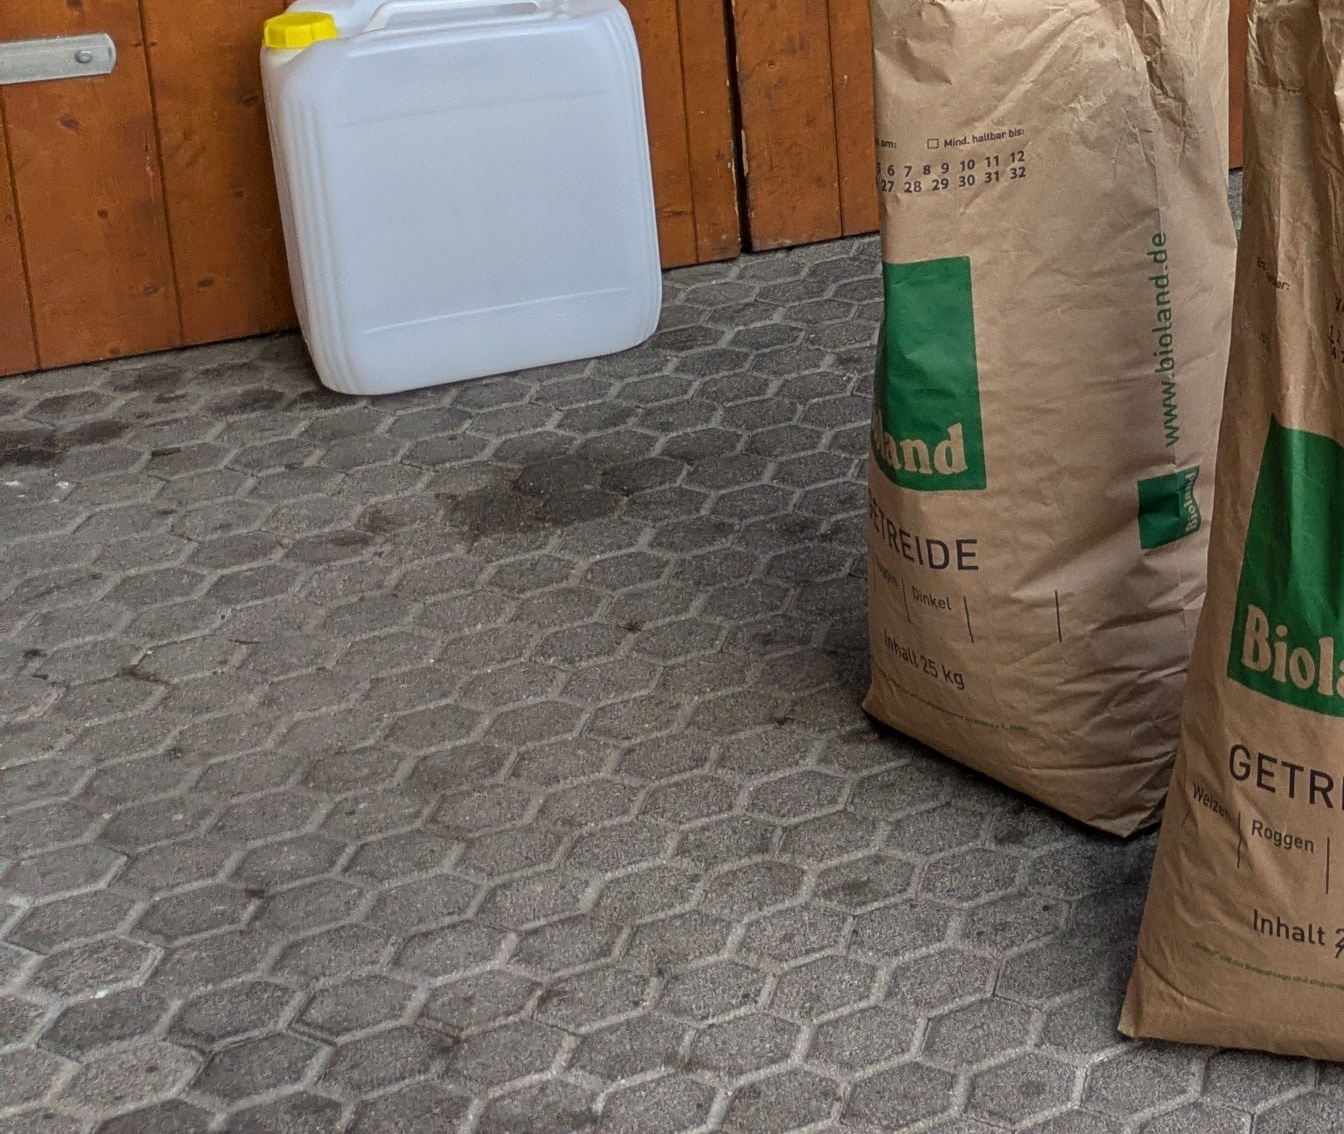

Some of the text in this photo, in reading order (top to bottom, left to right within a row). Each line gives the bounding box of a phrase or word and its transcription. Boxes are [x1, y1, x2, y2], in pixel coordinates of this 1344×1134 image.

[943, 136, 970, 148] Mind.
[972, 130, 1007, 144] haltbar
[1008, 127, 1025, 138] bis:
[881, 166, 1026, 193] 27 28 29 30 31 32
[887, 165, 895, 177] 6
[903, 166, 912, 177] 7
[922, 165, 931, 175] 8
[941, 162, 950, 174] 9
[959, 159, 976, 172] 10
[985, 155, 1000, 167] 11
[1009, 150, 1025, 163] 12
[1147, 232, 1179, 448] www.bioland.de
[911, 585, 952, 611] Dinkel
[884, 627, 965, 691] Inhalt 25 kg
[1192, 782, 1232, 822] Weizen
[1251, 819, 1314, 853] Roggen
[1252, 908, 1326, 947] Inhalt
